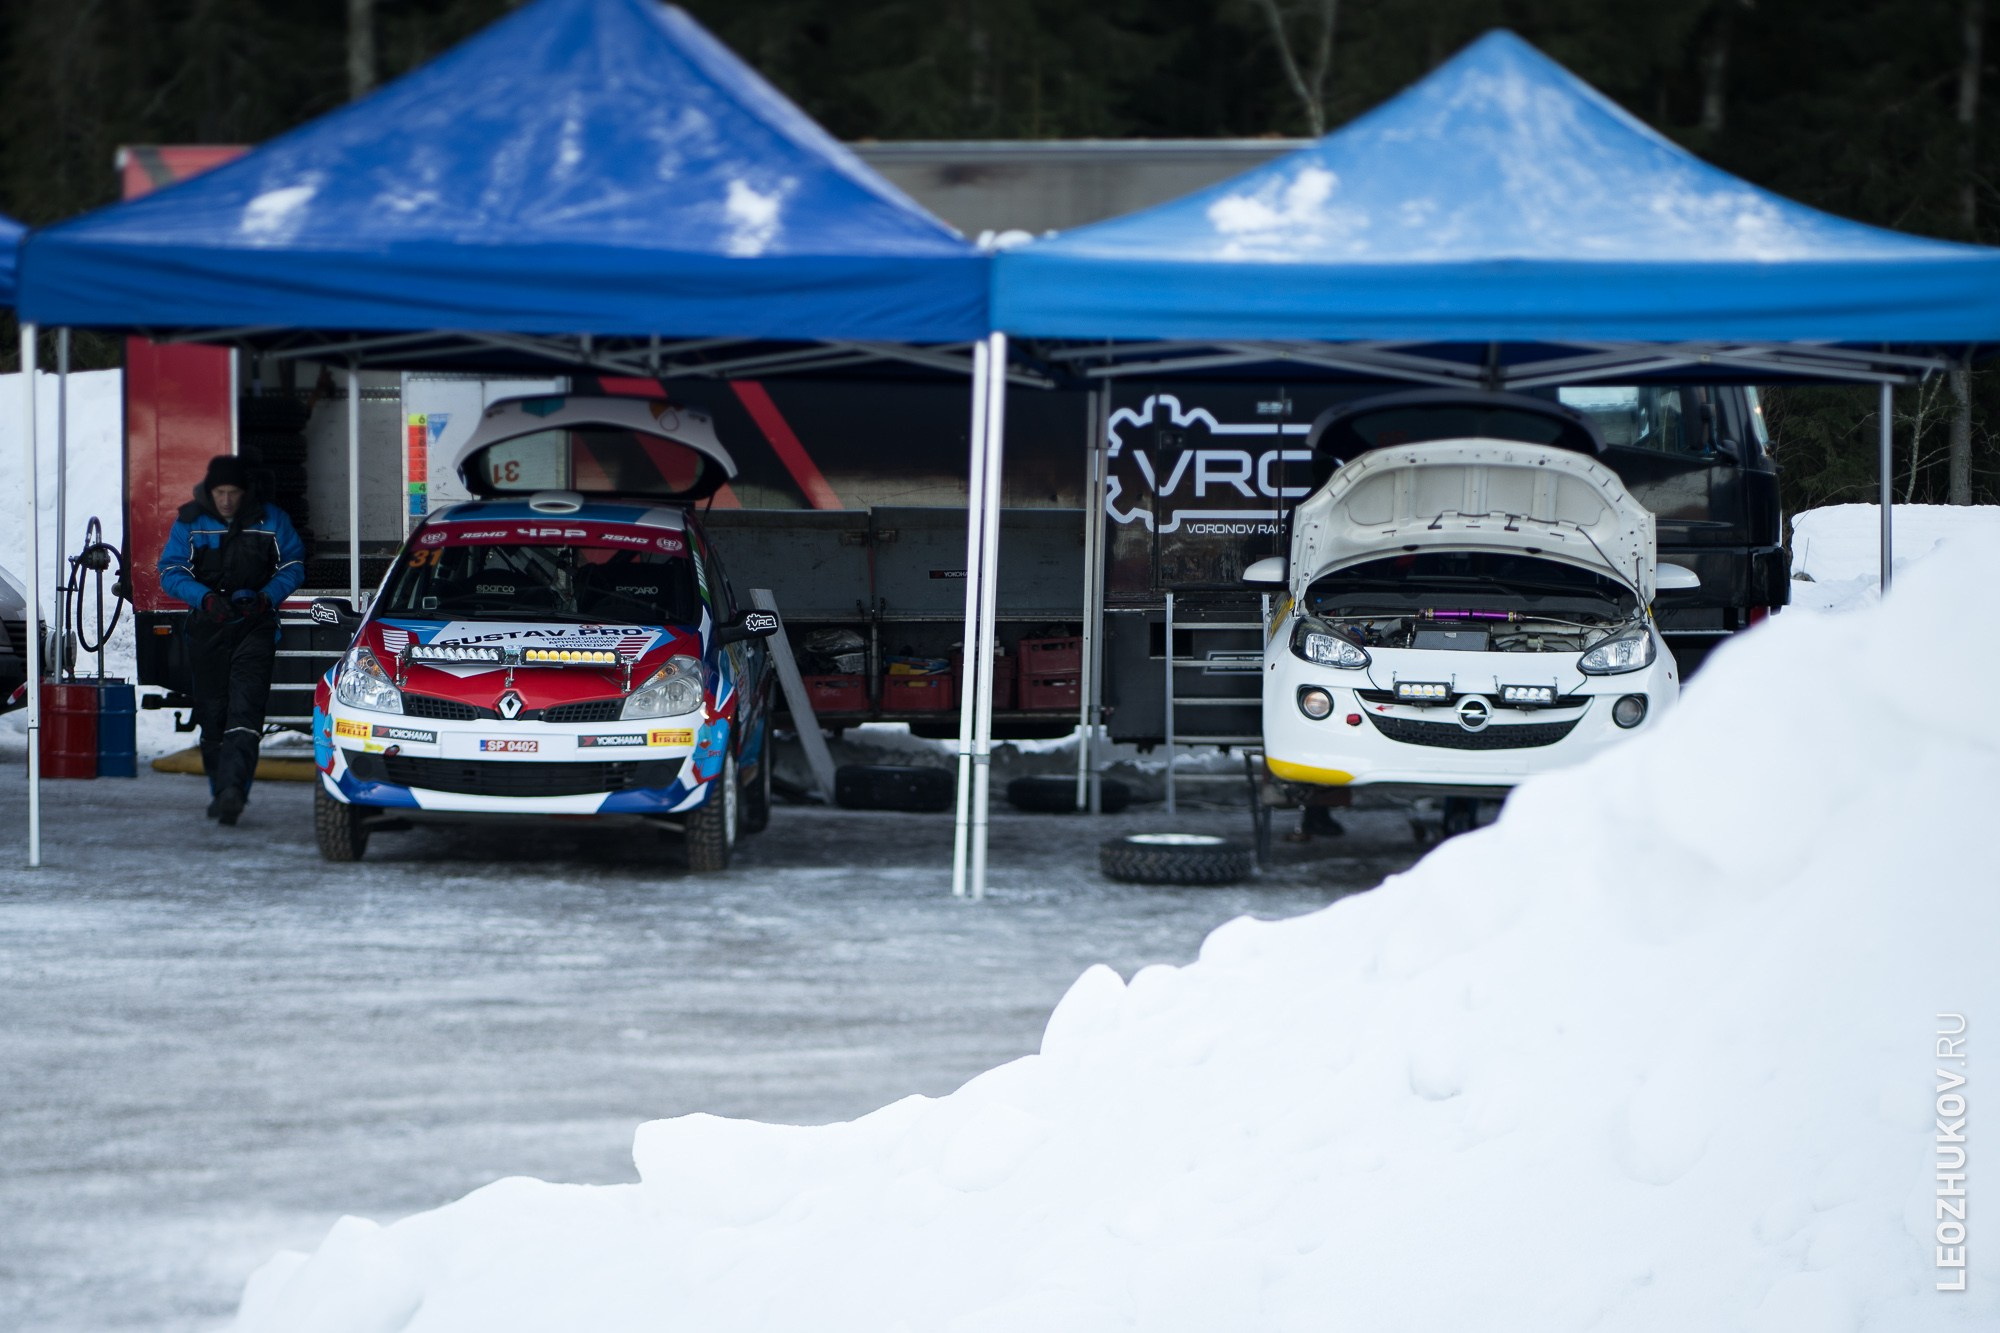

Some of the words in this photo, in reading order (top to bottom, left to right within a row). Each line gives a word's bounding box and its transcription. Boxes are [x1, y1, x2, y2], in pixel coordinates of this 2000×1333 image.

[1133, 450, 1311, 496] VRC
[419, 483, 426, 493] 4
[1187, 523, 1256, 534] VORONOV
[409, 549, 443, 568] 31
[476, 584, 515, 594] sparco
[316, 608, 335, 620] VRC
[751, 618, 773, 627] VRC
[440, 628, 643, 647] GUSTAV.PRO
[389, 727, 433, 742] YOKOHAMA
[597, 735, 643, 745] YOKOHAMA
[653, 731, 692, 744] PIRELLI
[487, 741, 505, 752] SP
[507, 742, 537, 752] 0402
